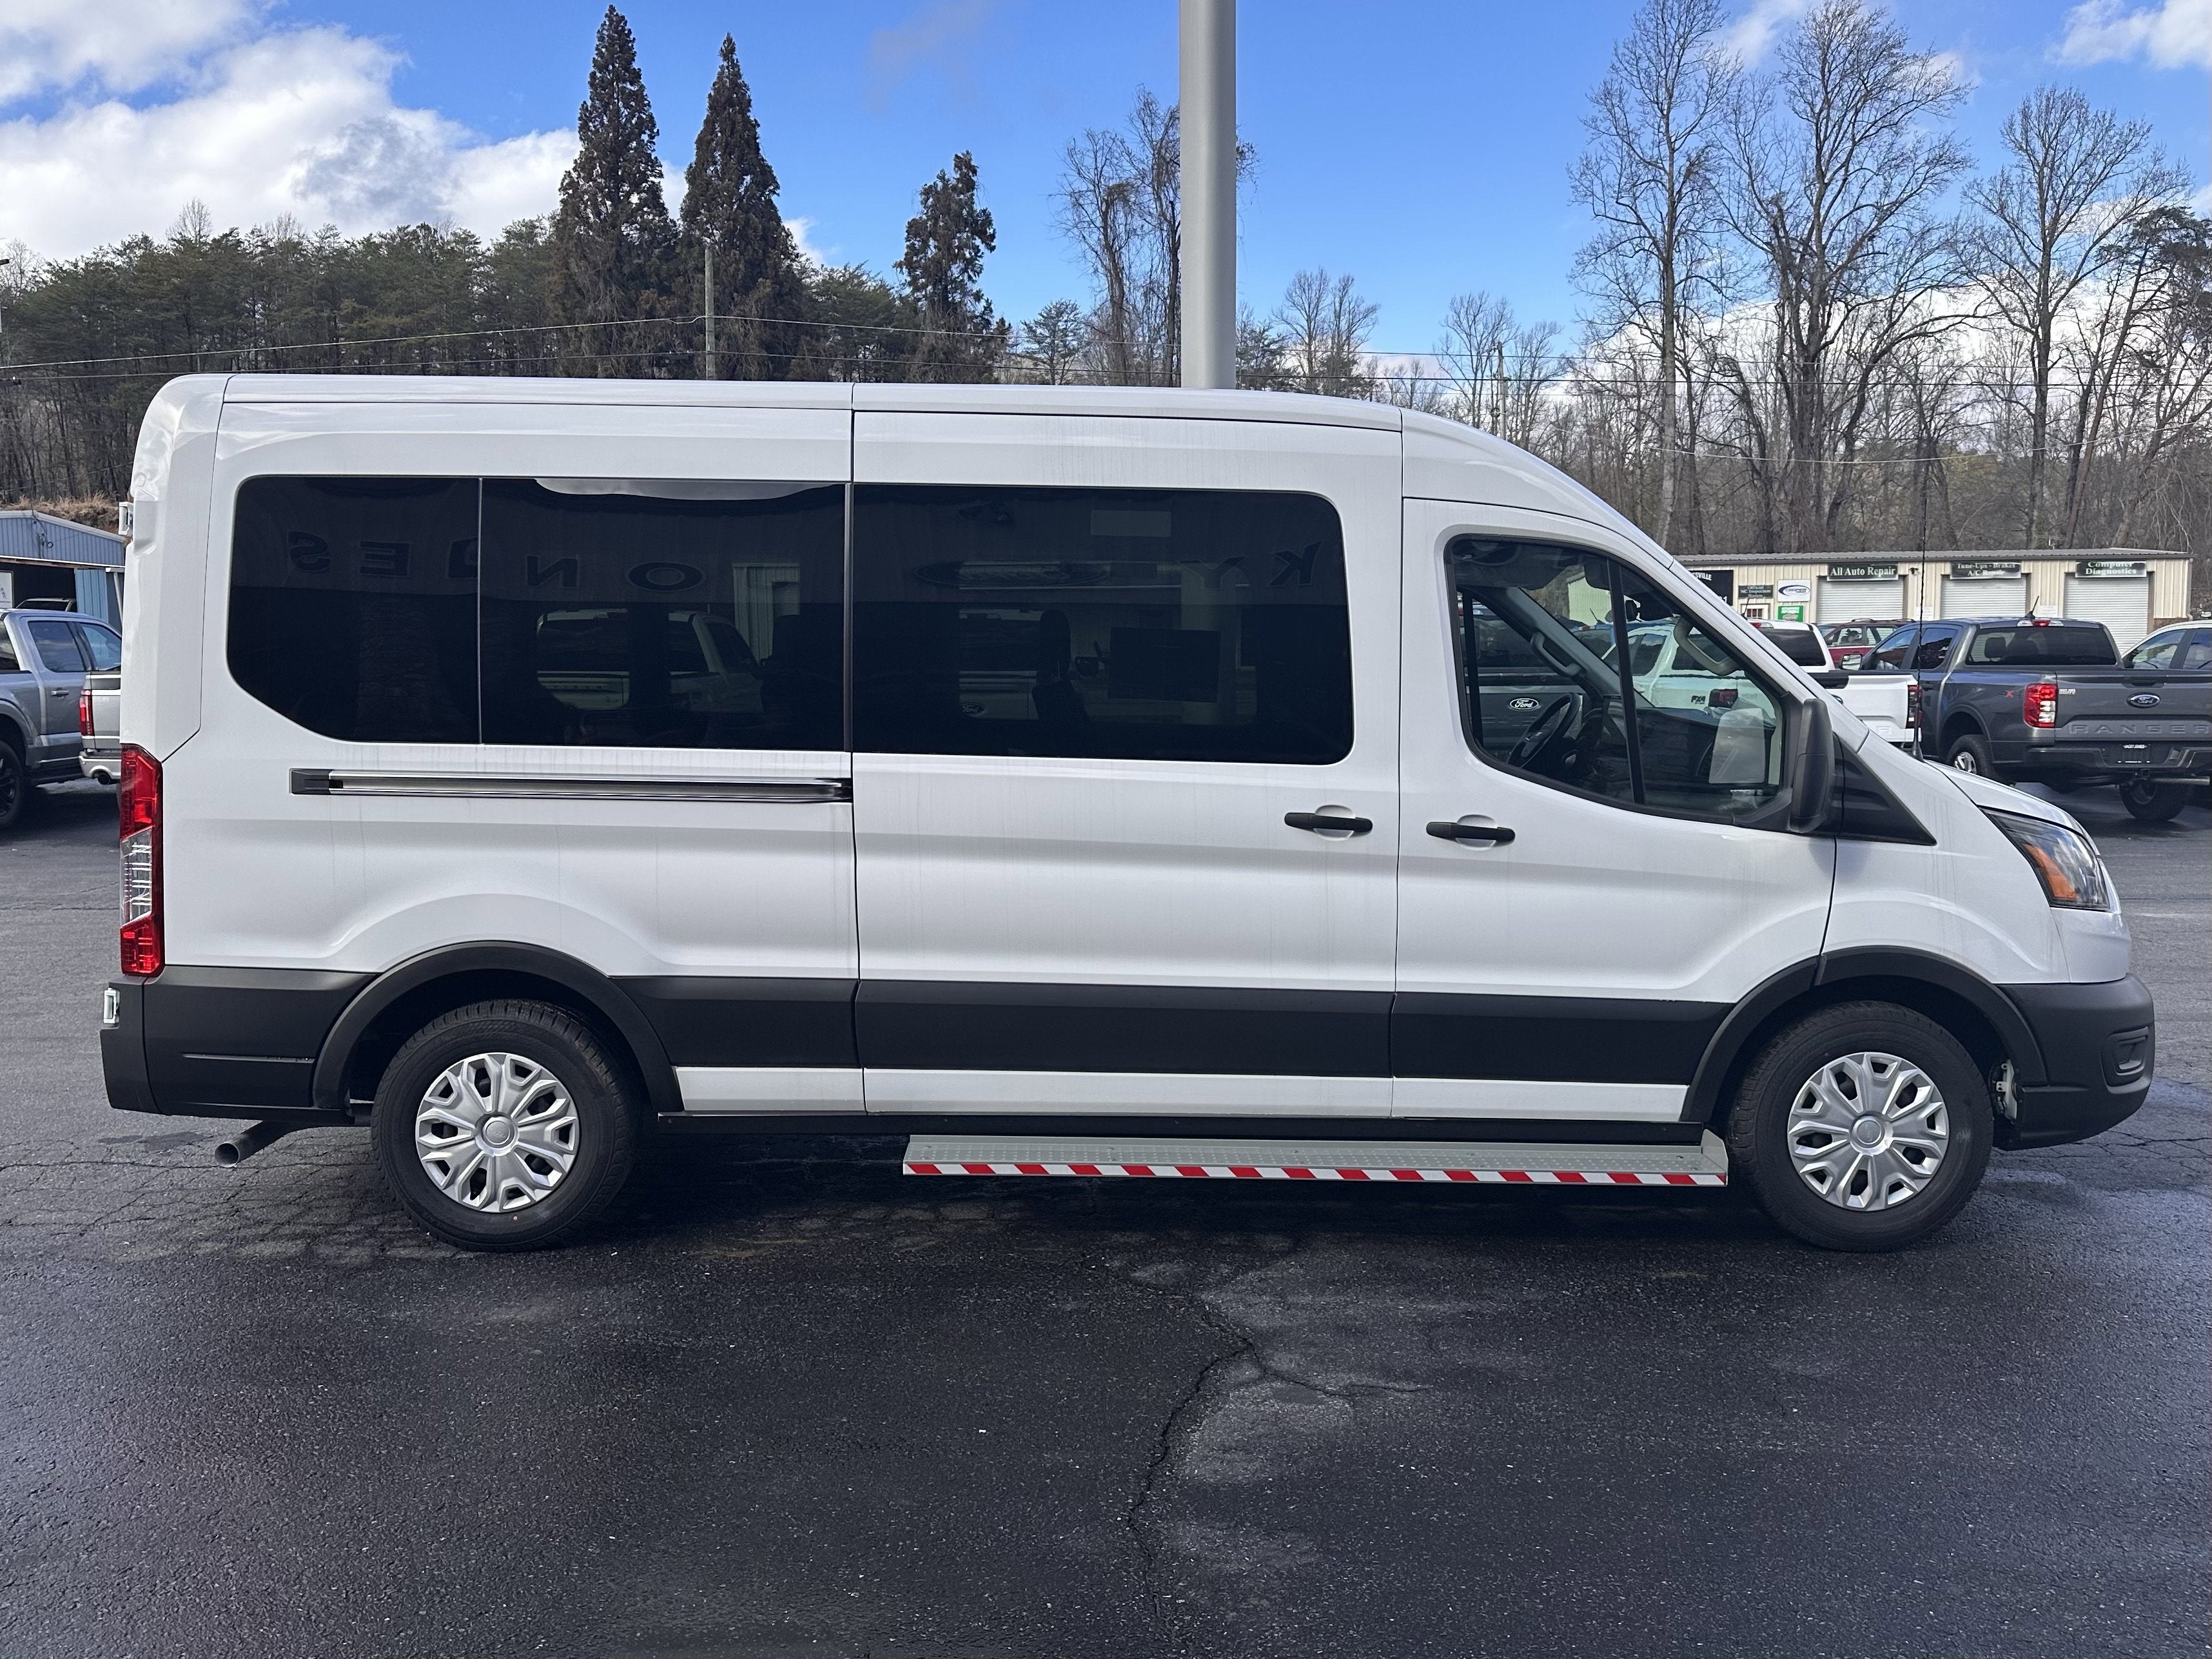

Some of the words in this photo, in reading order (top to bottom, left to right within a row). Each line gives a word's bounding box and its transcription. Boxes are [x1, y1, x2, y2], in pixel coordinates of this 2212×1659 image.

[1830, 567, 1843, 576] All
[1845, 567, 1865, 576] Auto
[1867, 566, 1896, 577] Repair
[1514, 700, 1534, 708] Ford
[2069, 725, 2209, 734] RANGER
